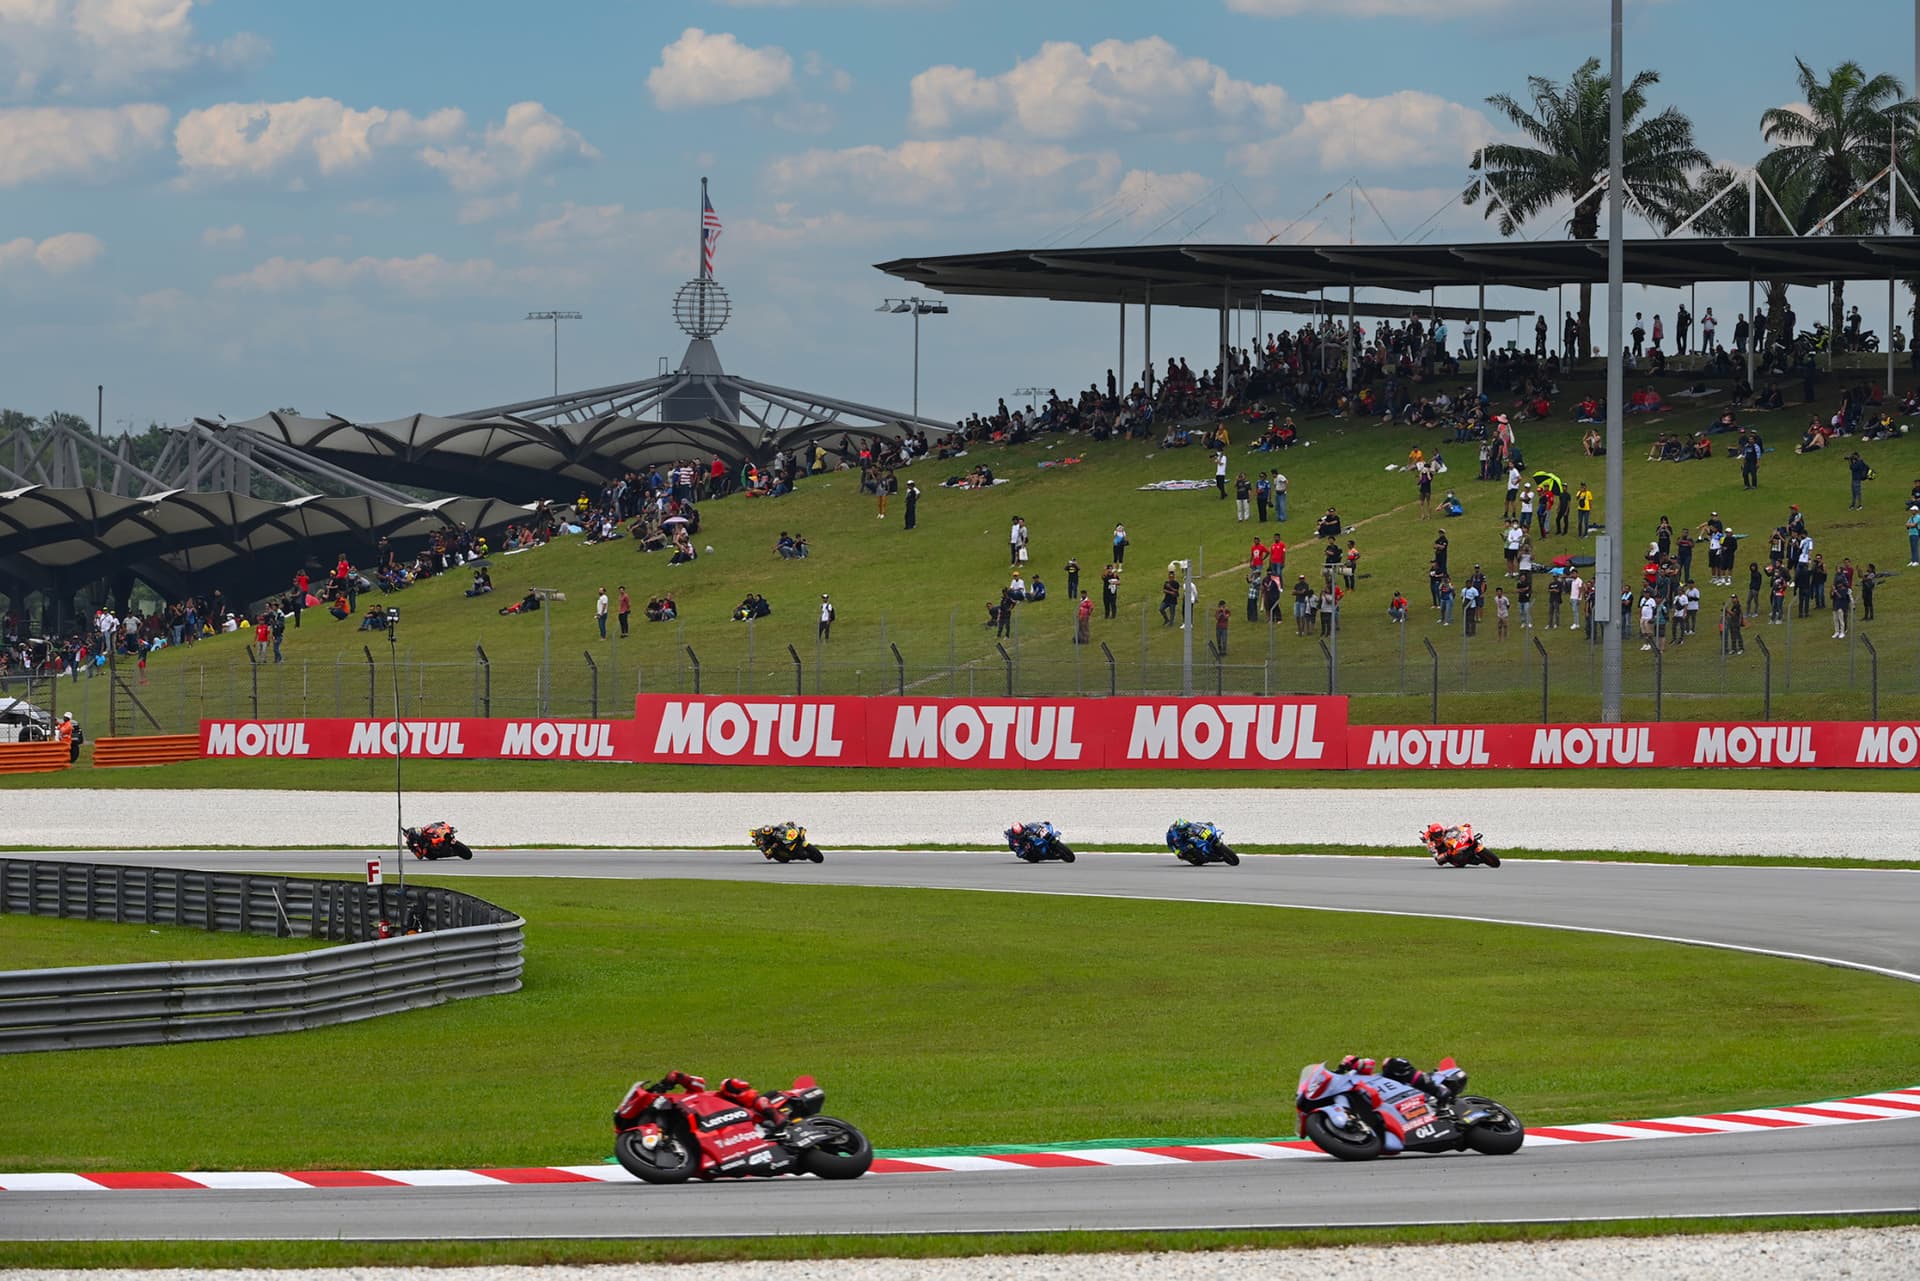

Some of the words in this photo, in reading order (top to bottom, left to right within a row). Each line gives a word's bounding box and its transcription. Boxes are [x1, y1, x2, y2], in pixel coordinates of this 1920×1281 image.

[206, 722, 309, 755] MOTUL
[348, 721, 465, 755] MOTUL
[500, 722, 614, 756] MOTUL
[654, 702, 843, 758] MOTUL
[889, 704, 1083, 760] MOTUL
[1127, 704, 1325, 760] MOTUL
[1367, 729, 1490, 766] MOTUL
[1530, 727, 1655, 765] MOTUL
[1693, 726, 1817, 764] MOTUL
[1856, 726, 1920, 764] MO
[368, 861, 380, 882] F
[702, 1110, 747, 1127] Lenovo
